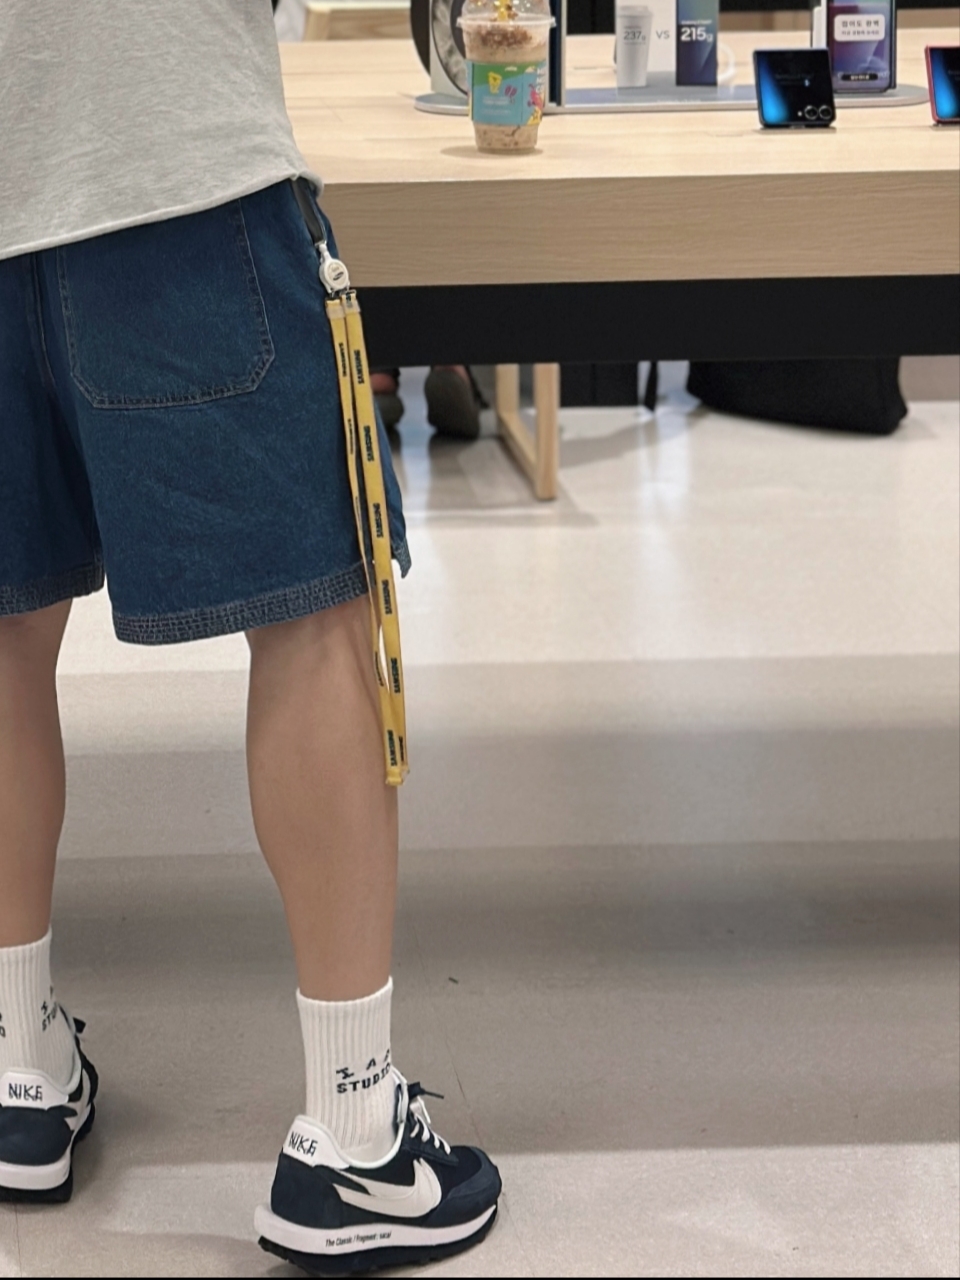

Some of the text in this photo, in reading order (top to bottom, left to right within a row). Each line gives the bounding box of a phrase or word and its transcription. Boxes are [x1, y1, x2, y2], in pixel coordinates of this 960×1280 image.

[655, 30, 670, 40] VS
[680, 27, 713, 42] 215g
[354, 349, 365, 385] SAMSUNG
[363, 425, 375, 462] SAMSUNG
[373, 503, 384, 539] SAMSUNG
[381, 579, 393, 615] SAMSUNG
[390, 657, 401, 694] SAMSUNG
[387, 729, 398, 767] SAMSUNG
